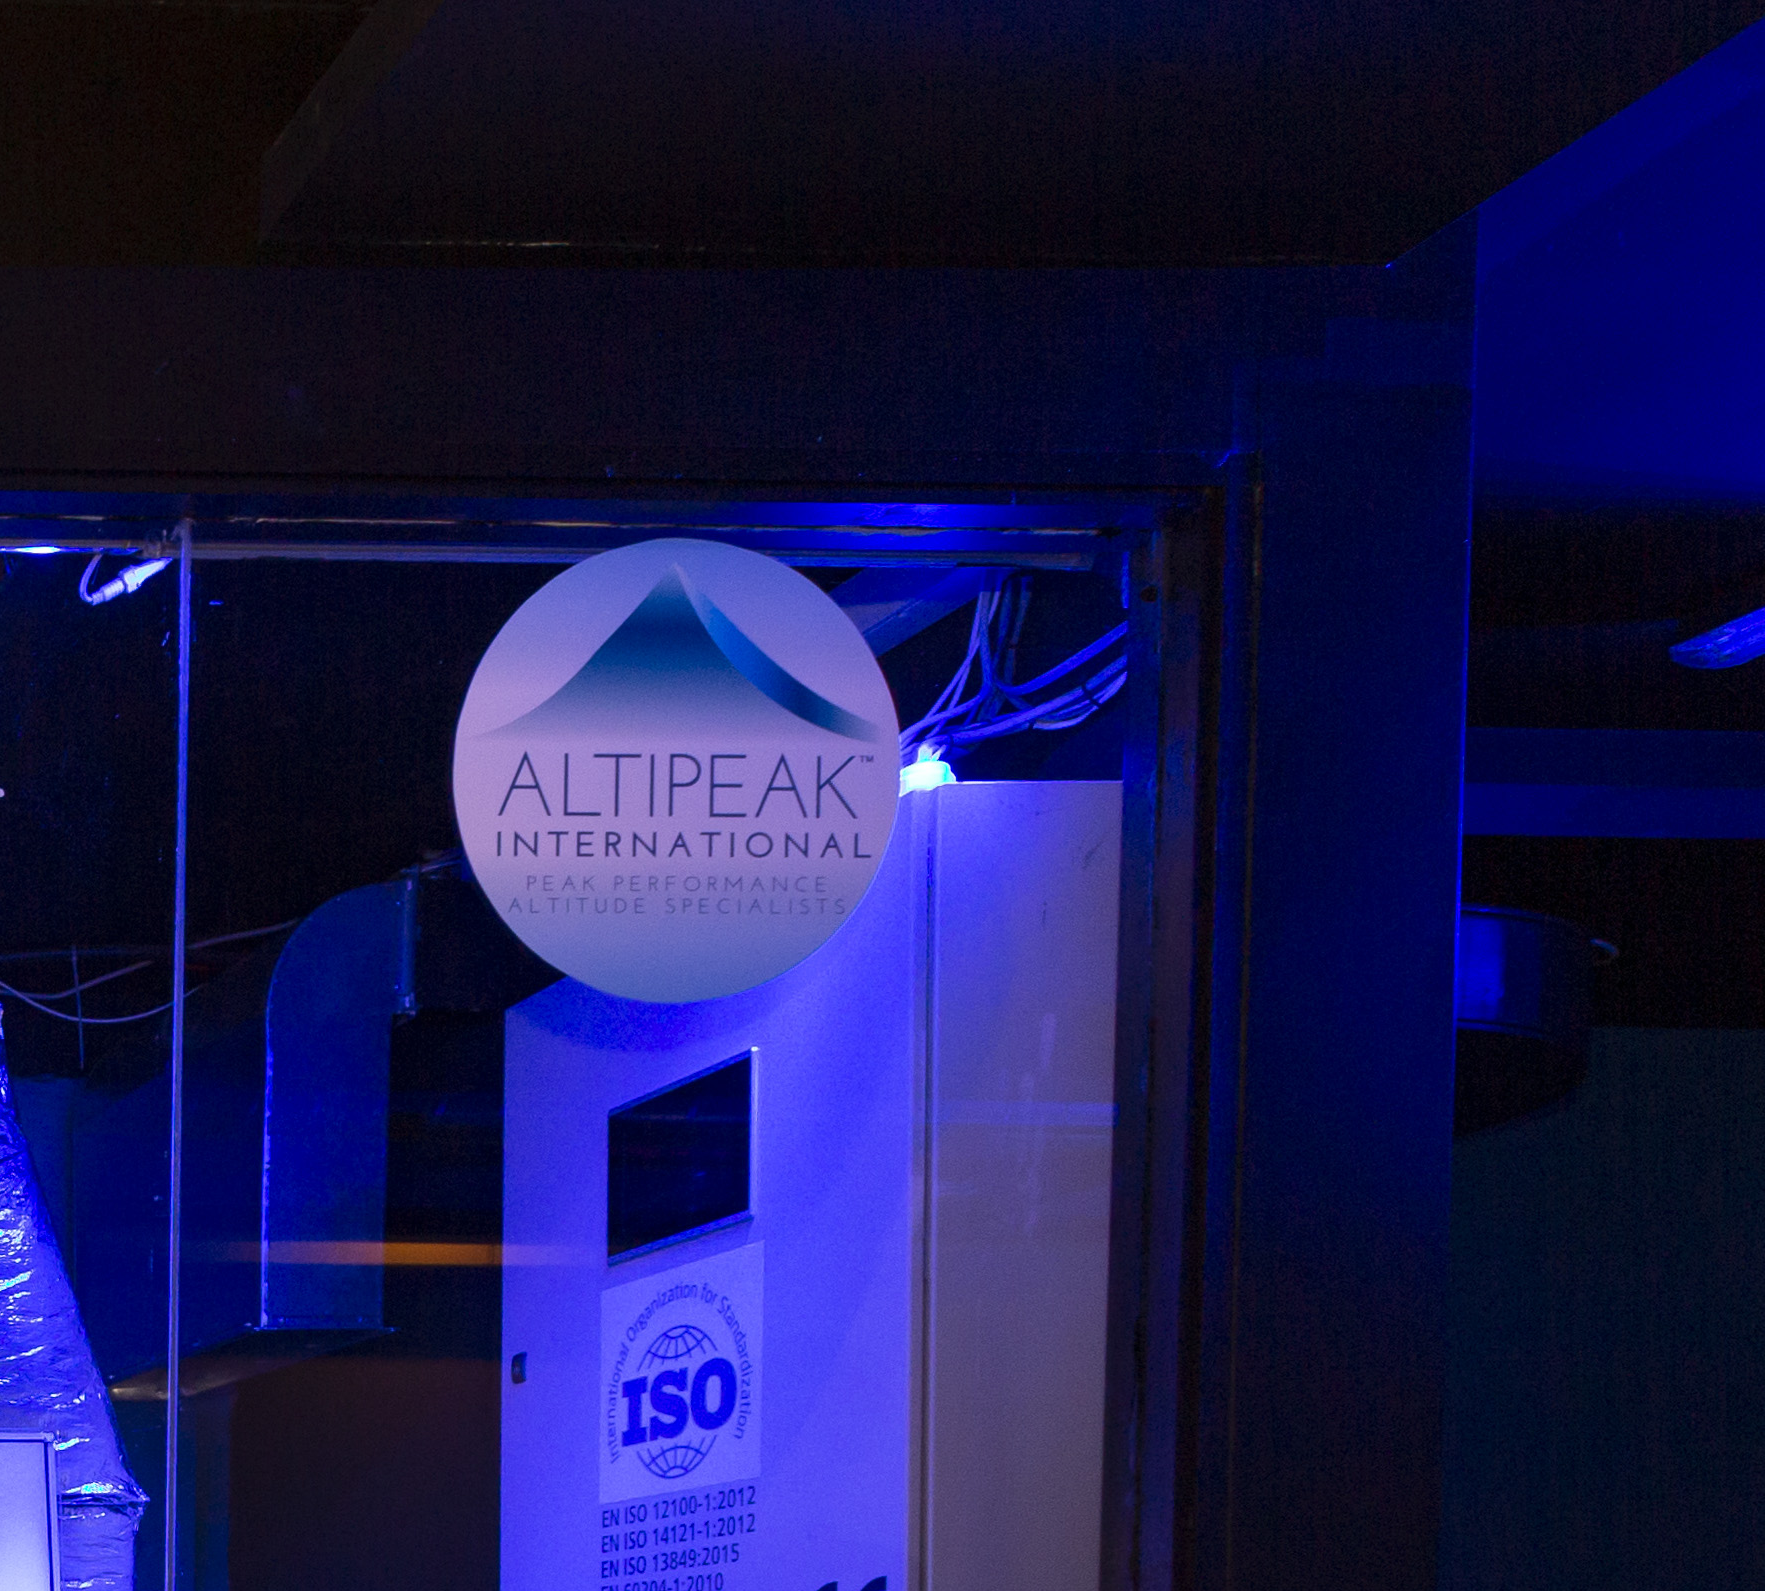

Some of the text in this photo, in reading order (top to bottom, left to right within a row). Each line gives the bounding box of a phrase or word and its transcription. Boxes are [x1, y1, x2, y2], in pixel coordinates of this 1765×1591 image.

[496, 831, 872, 859] INTERNATIONAL
[526, 875, 827, 892] PEAK PERFORMANCE
[508, 898, 845, 915] ALTITUDE SPECIALISTS
[607, 1282, 754, 1464] International Organization for Standardization
[622, 1357, 737, 1447] ISO
[602, 1486, 756, 1528] EN ISO 12100-1:2012
[601, 1514, 756, 1553] EN ISO 14121-1:2012
[601, 1543, 740, 1578] EN ISO 13849:2015
